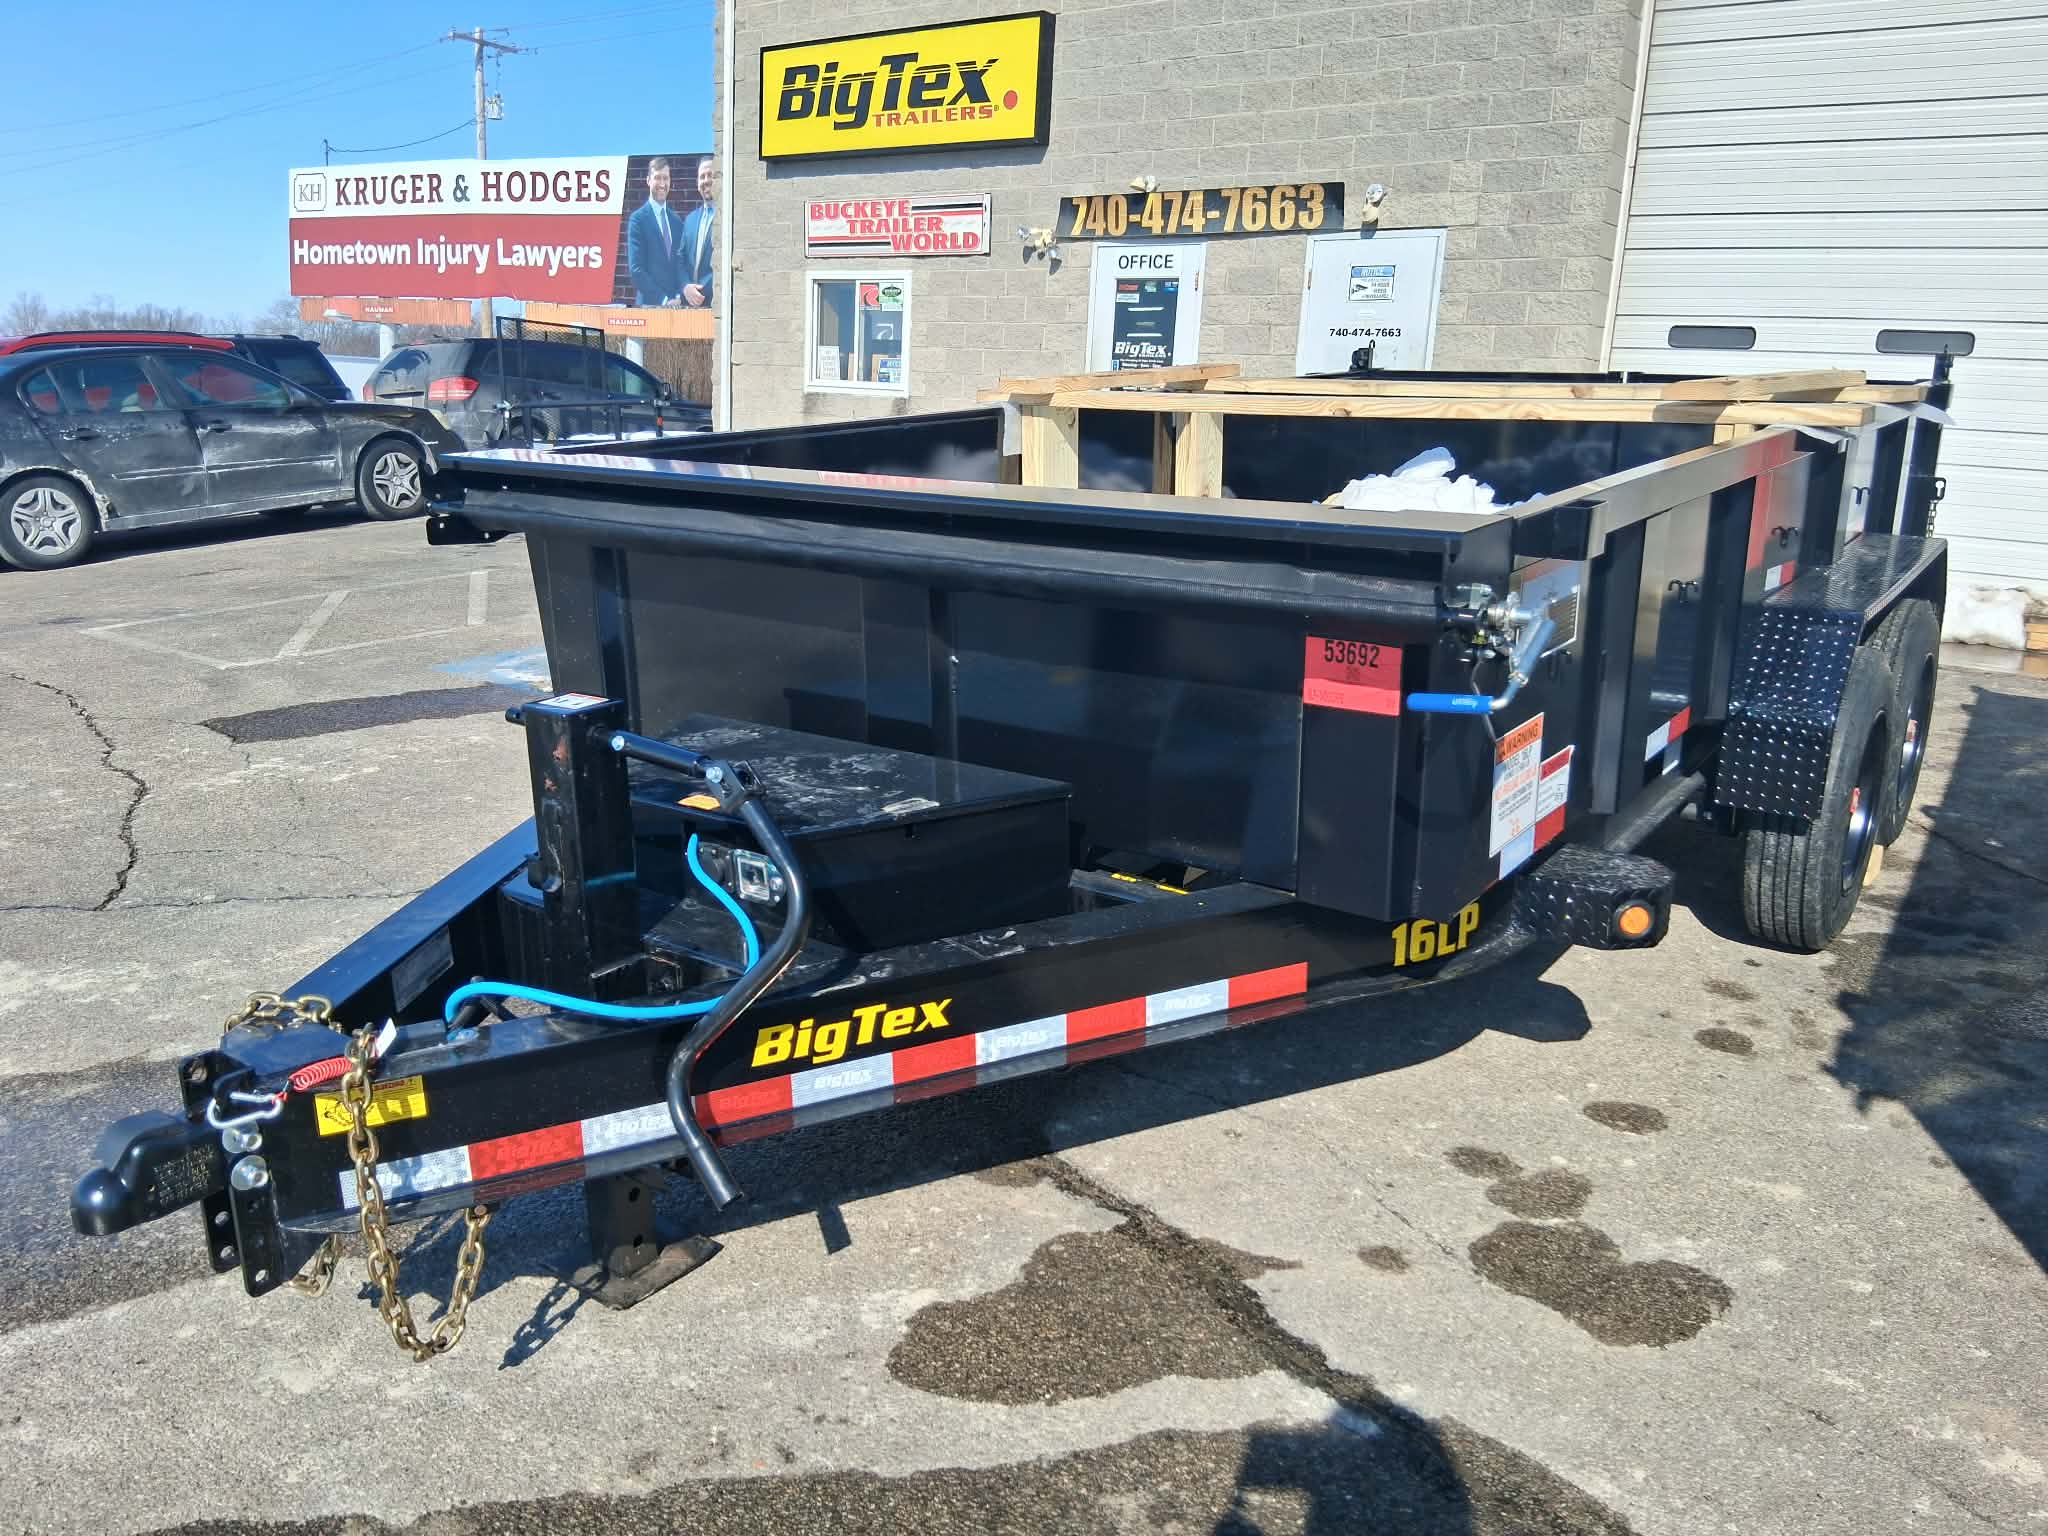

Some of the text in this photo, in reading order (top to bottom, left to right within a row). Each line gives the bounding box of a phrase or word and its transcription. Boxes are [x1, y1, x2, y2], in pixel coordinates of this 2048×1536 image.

[335, 170, 611, 206] KRUGER & HODGES
[810, 200, 911, 220] BUCKEYE
[1071, 184, 1325, 236] 740-474-7663
[847, 216, 943, 233] TRAILER
[891, 232, 981, 250] WORLD
[293, 236, 603, 276] Hometown Injury Lawyers
[1118, 254, 1174, 270] OFFICE
[1329, 328, 1401, 337] 740-474-7663
[1324, 639, 1380, 668] 53692
[1506, 724, 1539, 752] WARNING
[1391, 901, 1480, 967] 16LP
